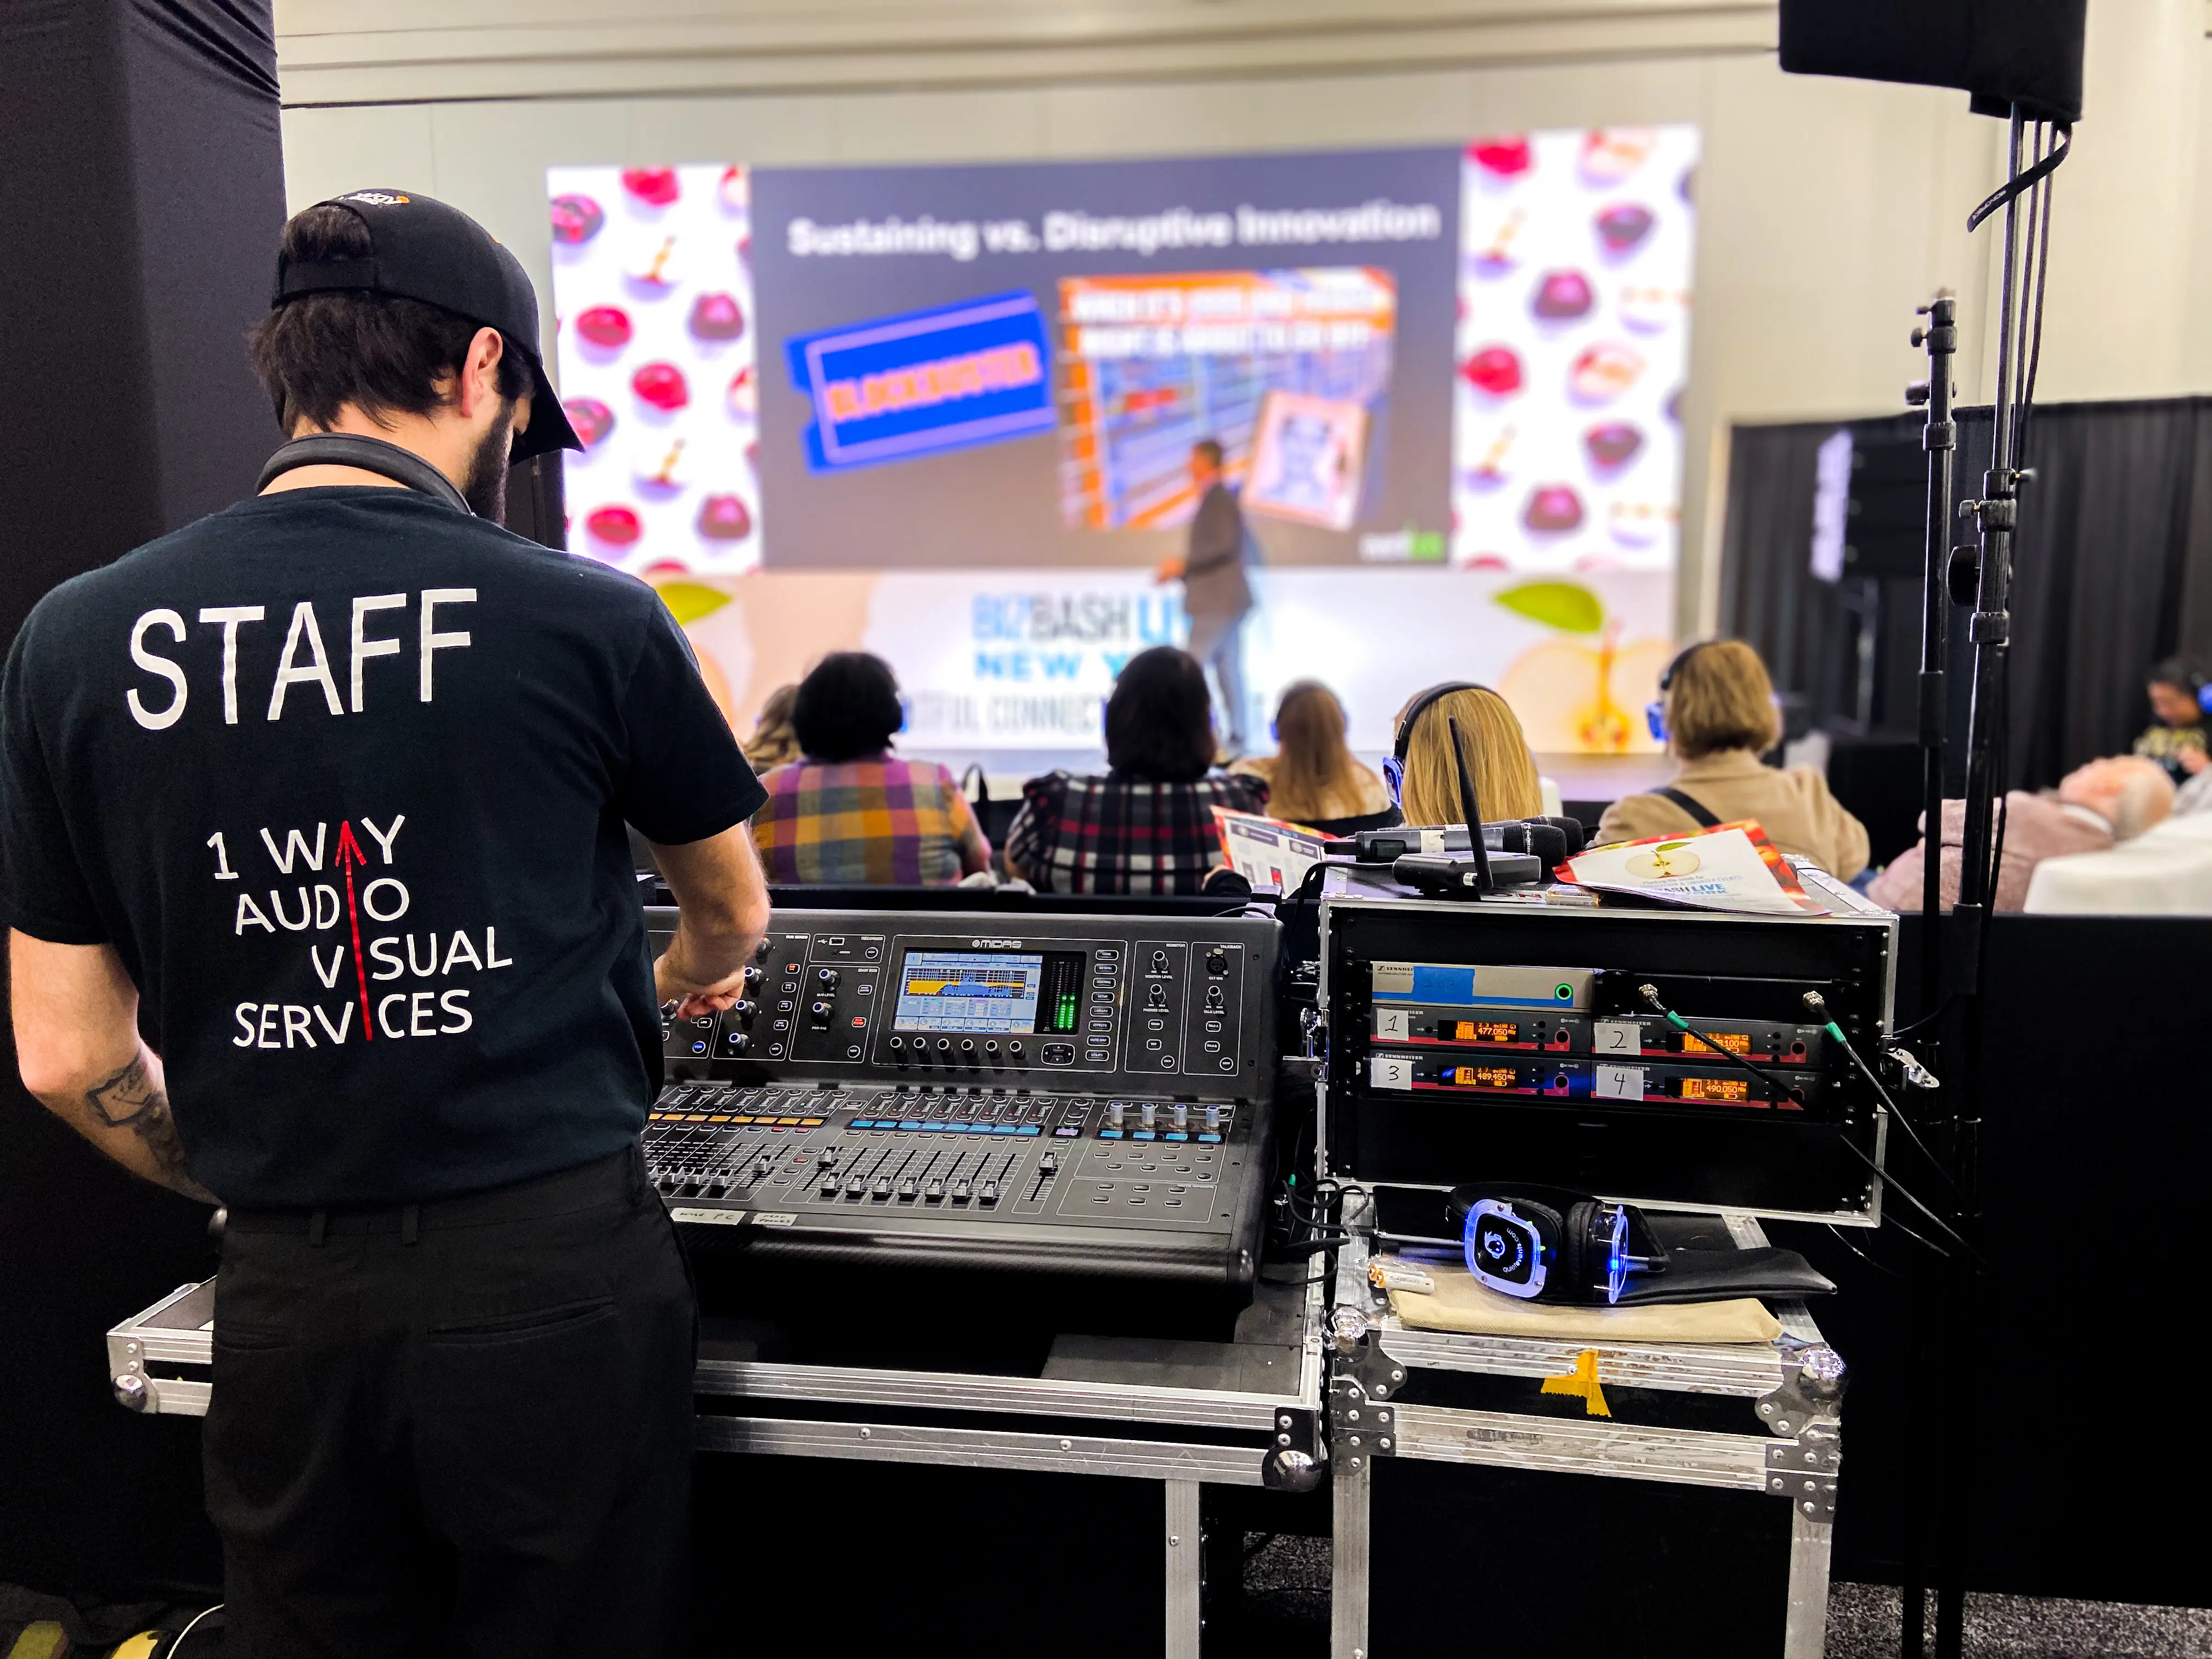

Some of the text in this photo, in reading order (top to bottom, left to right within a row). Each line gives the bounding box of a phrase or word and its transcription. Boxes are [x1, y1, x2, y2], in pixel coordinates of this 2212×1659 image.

[788, 203, 1441, 259] Sustaining vs. Disruptive Innovation
[127, 588, 477, 730] STAFF
[975, 652, 1082, 680] NEW
[206, 831, 239, 879] 1
[235, 878, 410, 936] AUDIO
[979, 940, 1023, 949] MIDAS
[312, 926, 513, 989] VISUAL
[232, 990, 473, 1049] SERVICES
[1385, 1015, 1398, 1031] 1
[1478, 1027, 1508, 1036] 477.050
[1609, 1031, 1627, 1048] 2
[1389, 1065, 1400, 1081] 3
[1477, 1073, 1507, 1081] 489.450
[1614, 1073, 1626, 1095] 4
[1706, 1085, 1737, 1093] 490.050
[1503, 1227, 1523, 1273] quietevents.com
